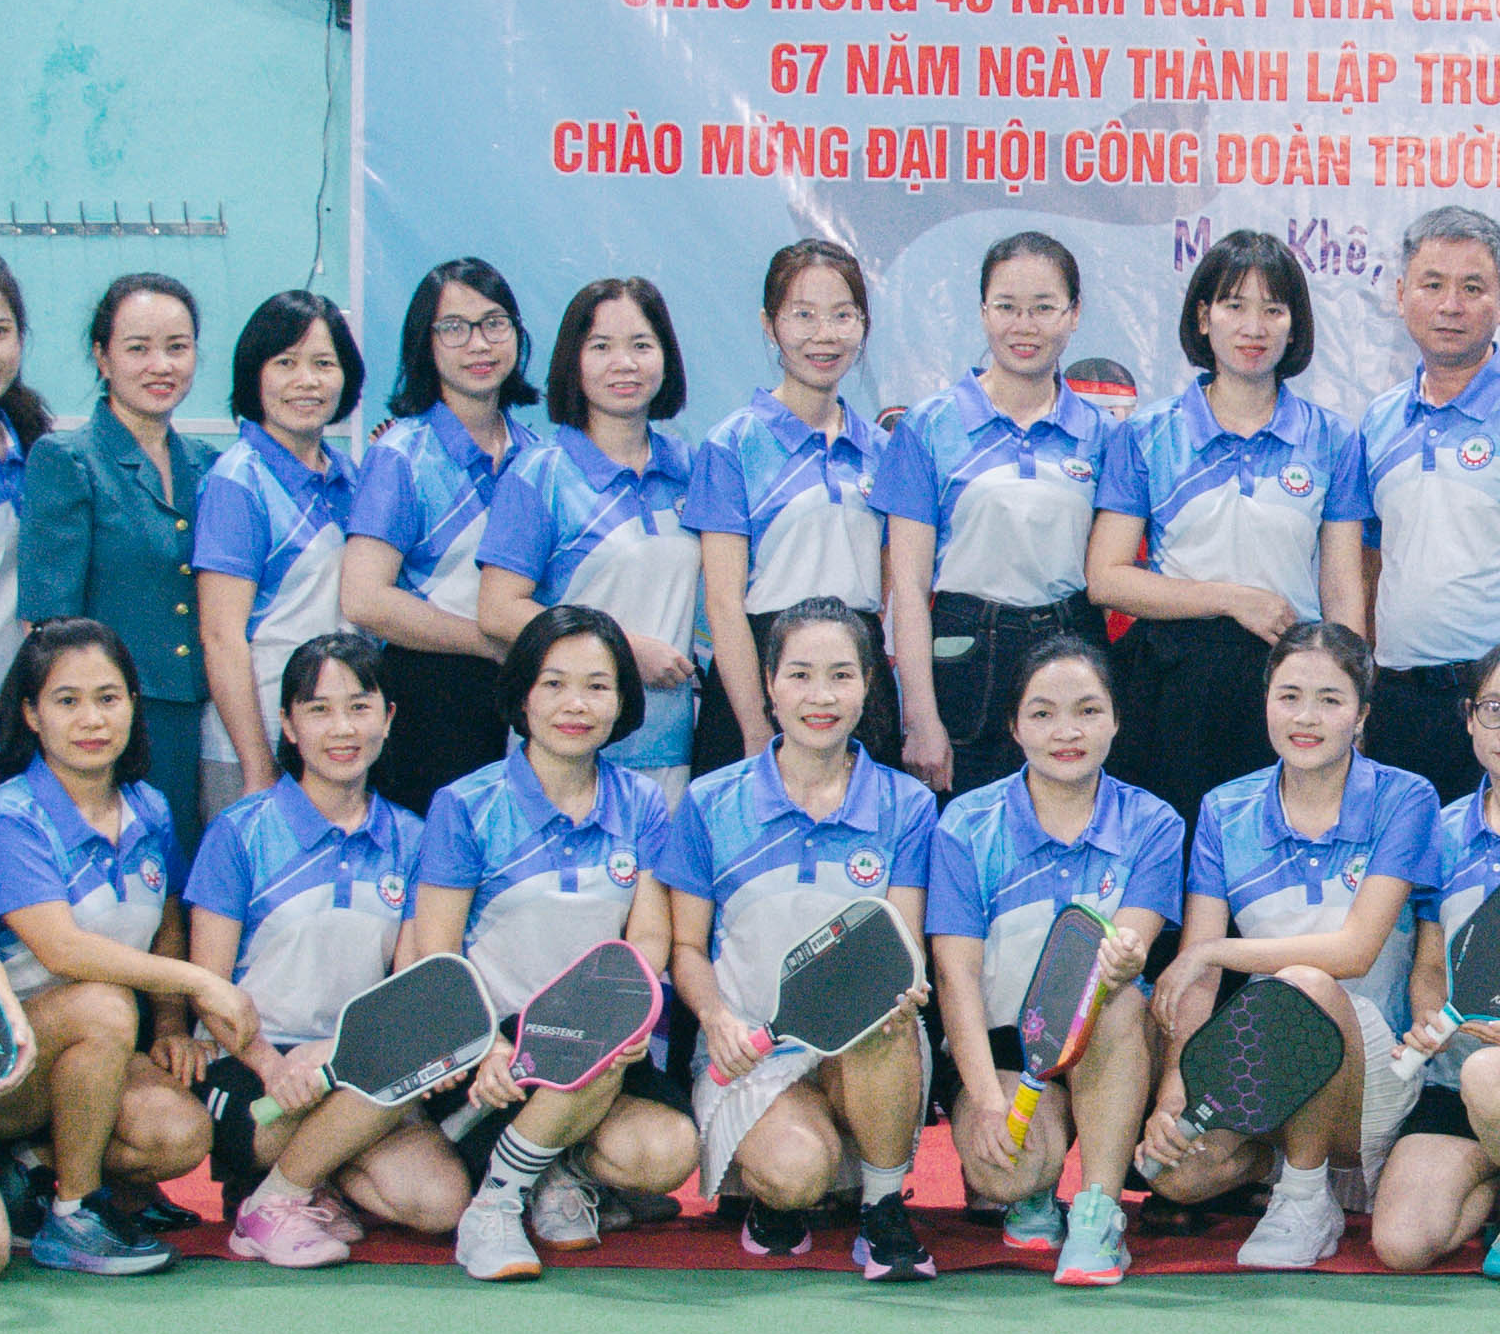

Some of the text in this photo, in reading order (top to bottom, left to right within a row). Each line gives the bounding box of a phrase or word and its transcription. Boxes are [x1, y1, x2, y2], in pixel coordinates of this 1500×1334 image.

[771, 43, 829, 95] 67
[846, 32, 960, 96] NĂM
[979, 36, 1110, 98] NGÀY
[1126, 38, 1289, 101] THÀNH
[1307, 41, 1397, 115] LẬP
[553, 110, 682, 175] CHÀO
[702, 114, 849, 178] MỪNG
[866, 128, 946, 191] ĐẠI
[966, 118, 1046, 193] HỘI
[1064, 119, 1199, 184] CÔNG
[1216, 123, 1351, 186] ĐOÀN
[1287, 217, 1384, 286] Khê,
[524, 1023, 586, 1040] PERSISTENCE
